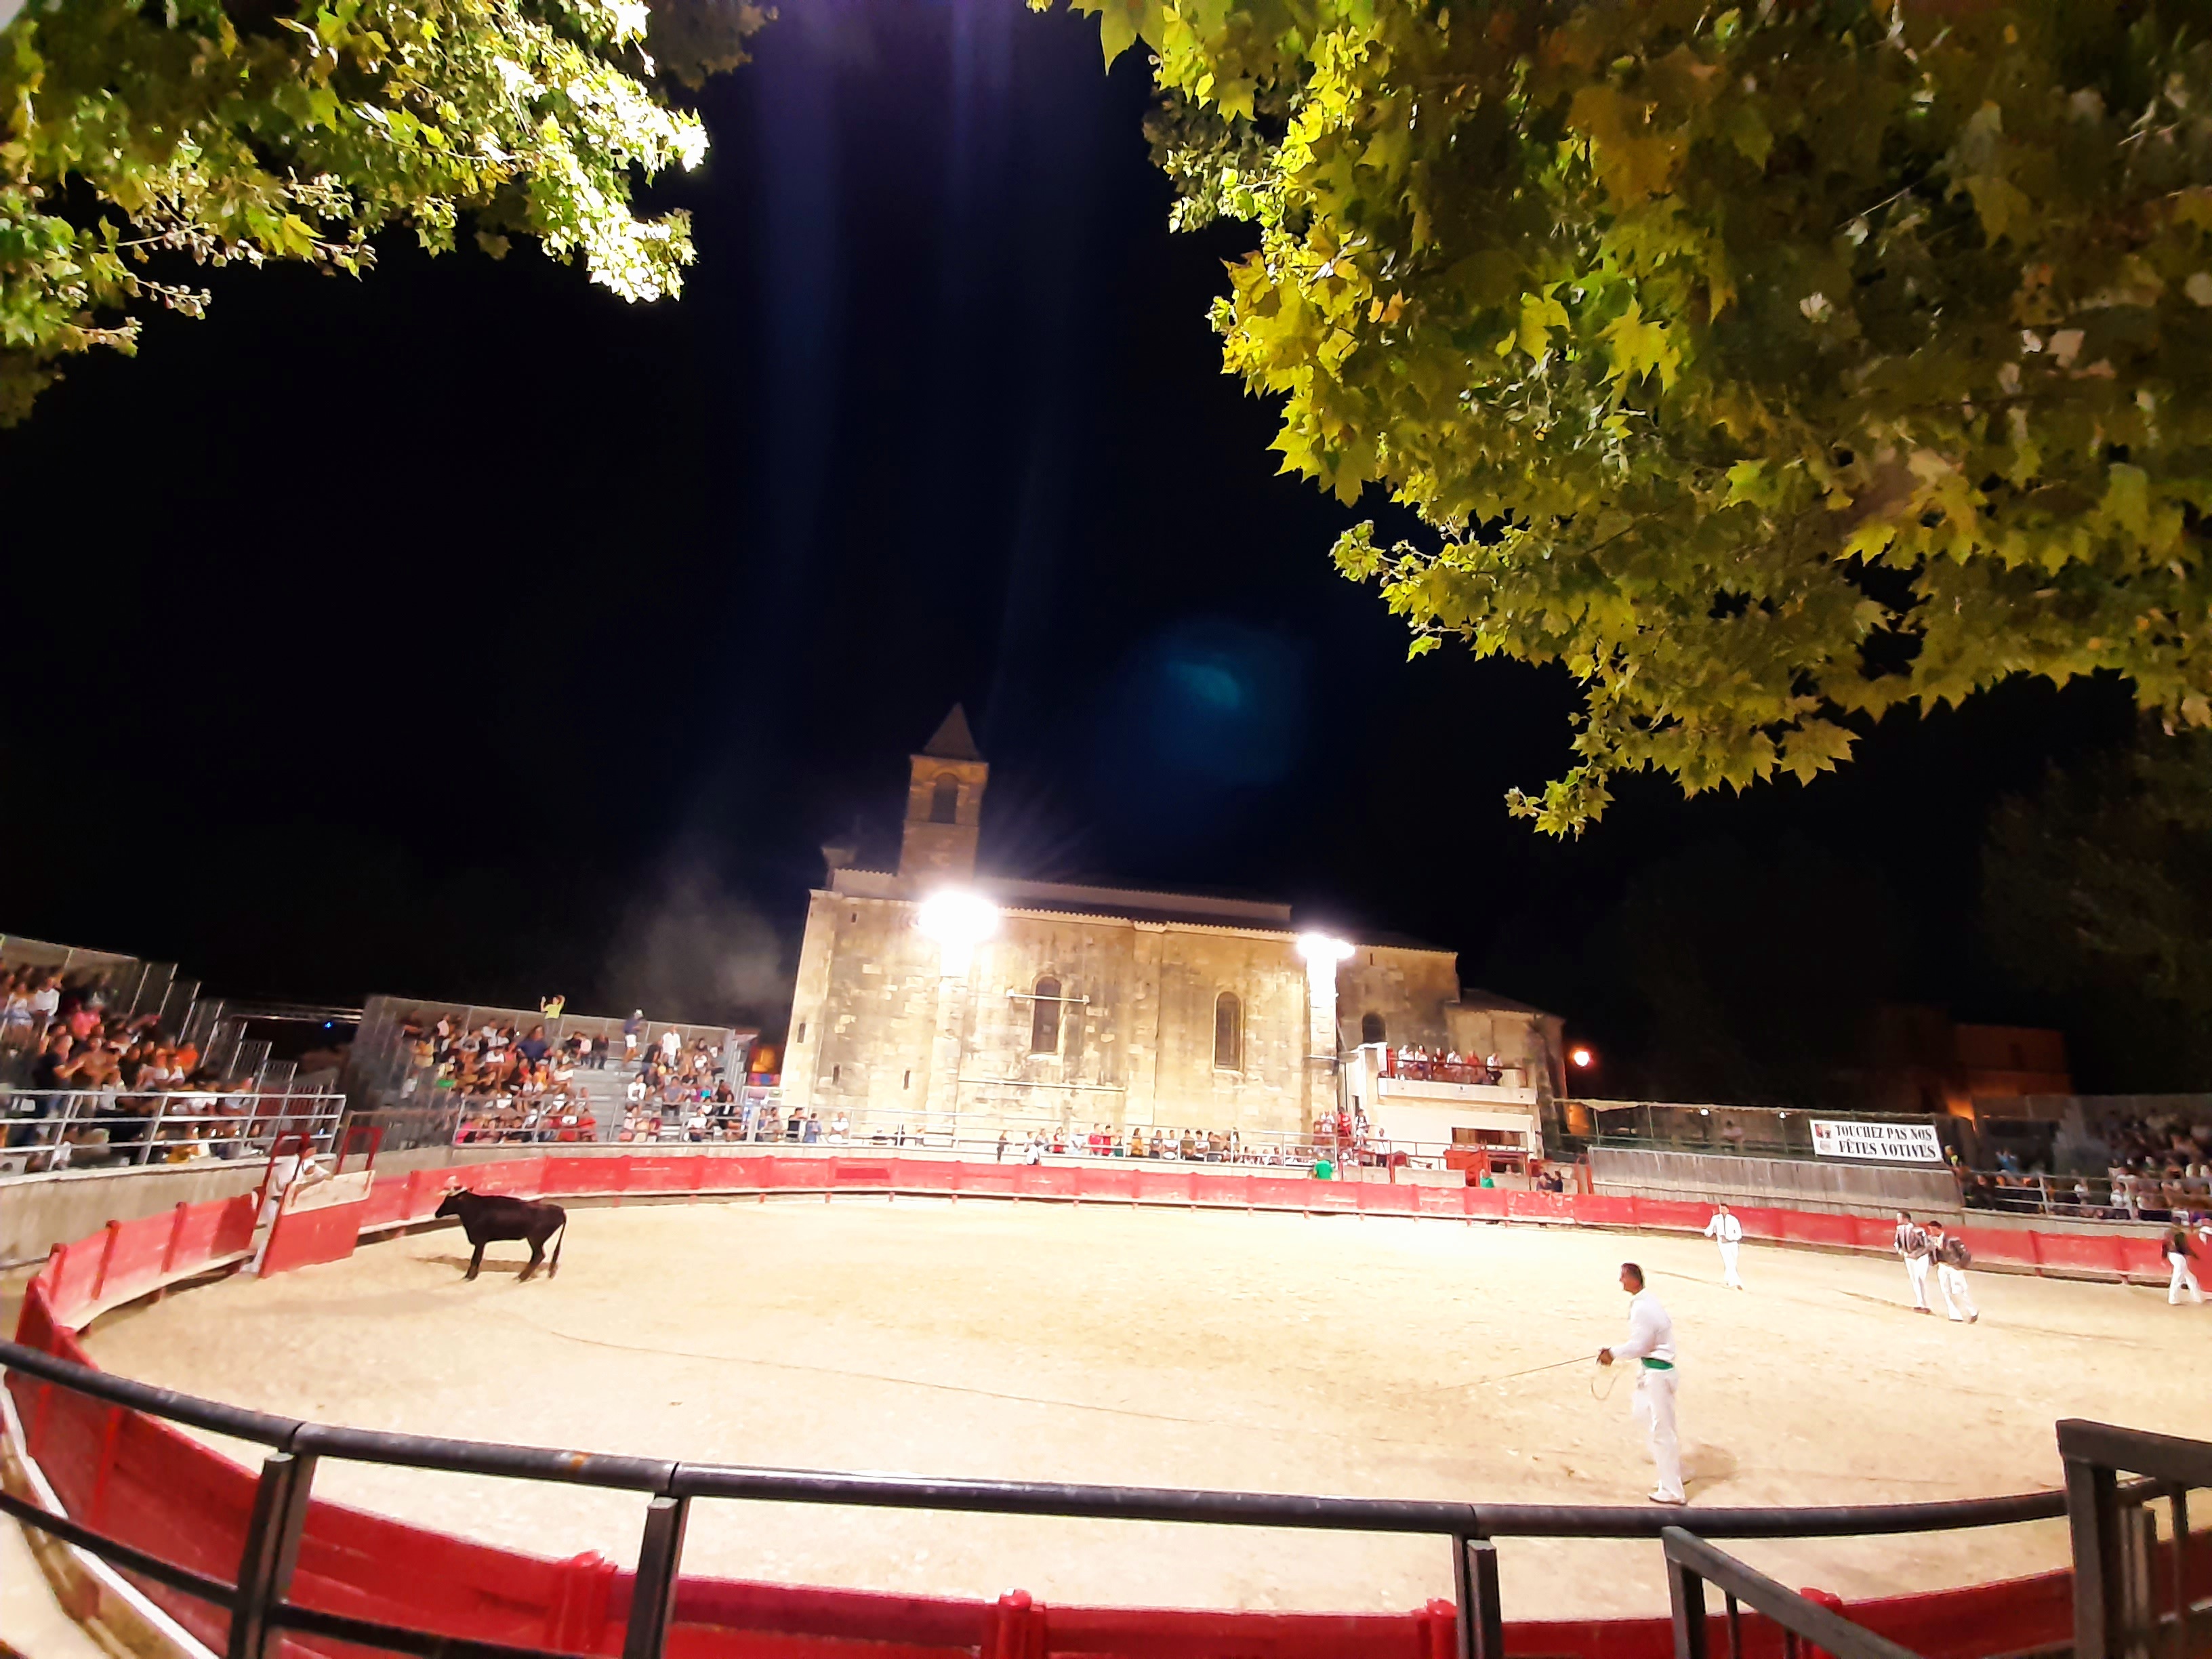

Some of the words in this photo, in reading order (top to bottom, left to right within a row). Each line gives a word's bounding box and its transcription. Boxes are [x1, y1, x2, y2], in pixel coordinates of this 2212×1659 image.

[1835, 1125, 1884, 1139] TOUCHEZ
[1887, 1128, 1908, 1140] PAS
[1910, 1128, 1932, 1141] NOS
[1839, 1139, 1877, 1155] FÊTES
[1881, 1143, 1936, 1158] VOTIVES
